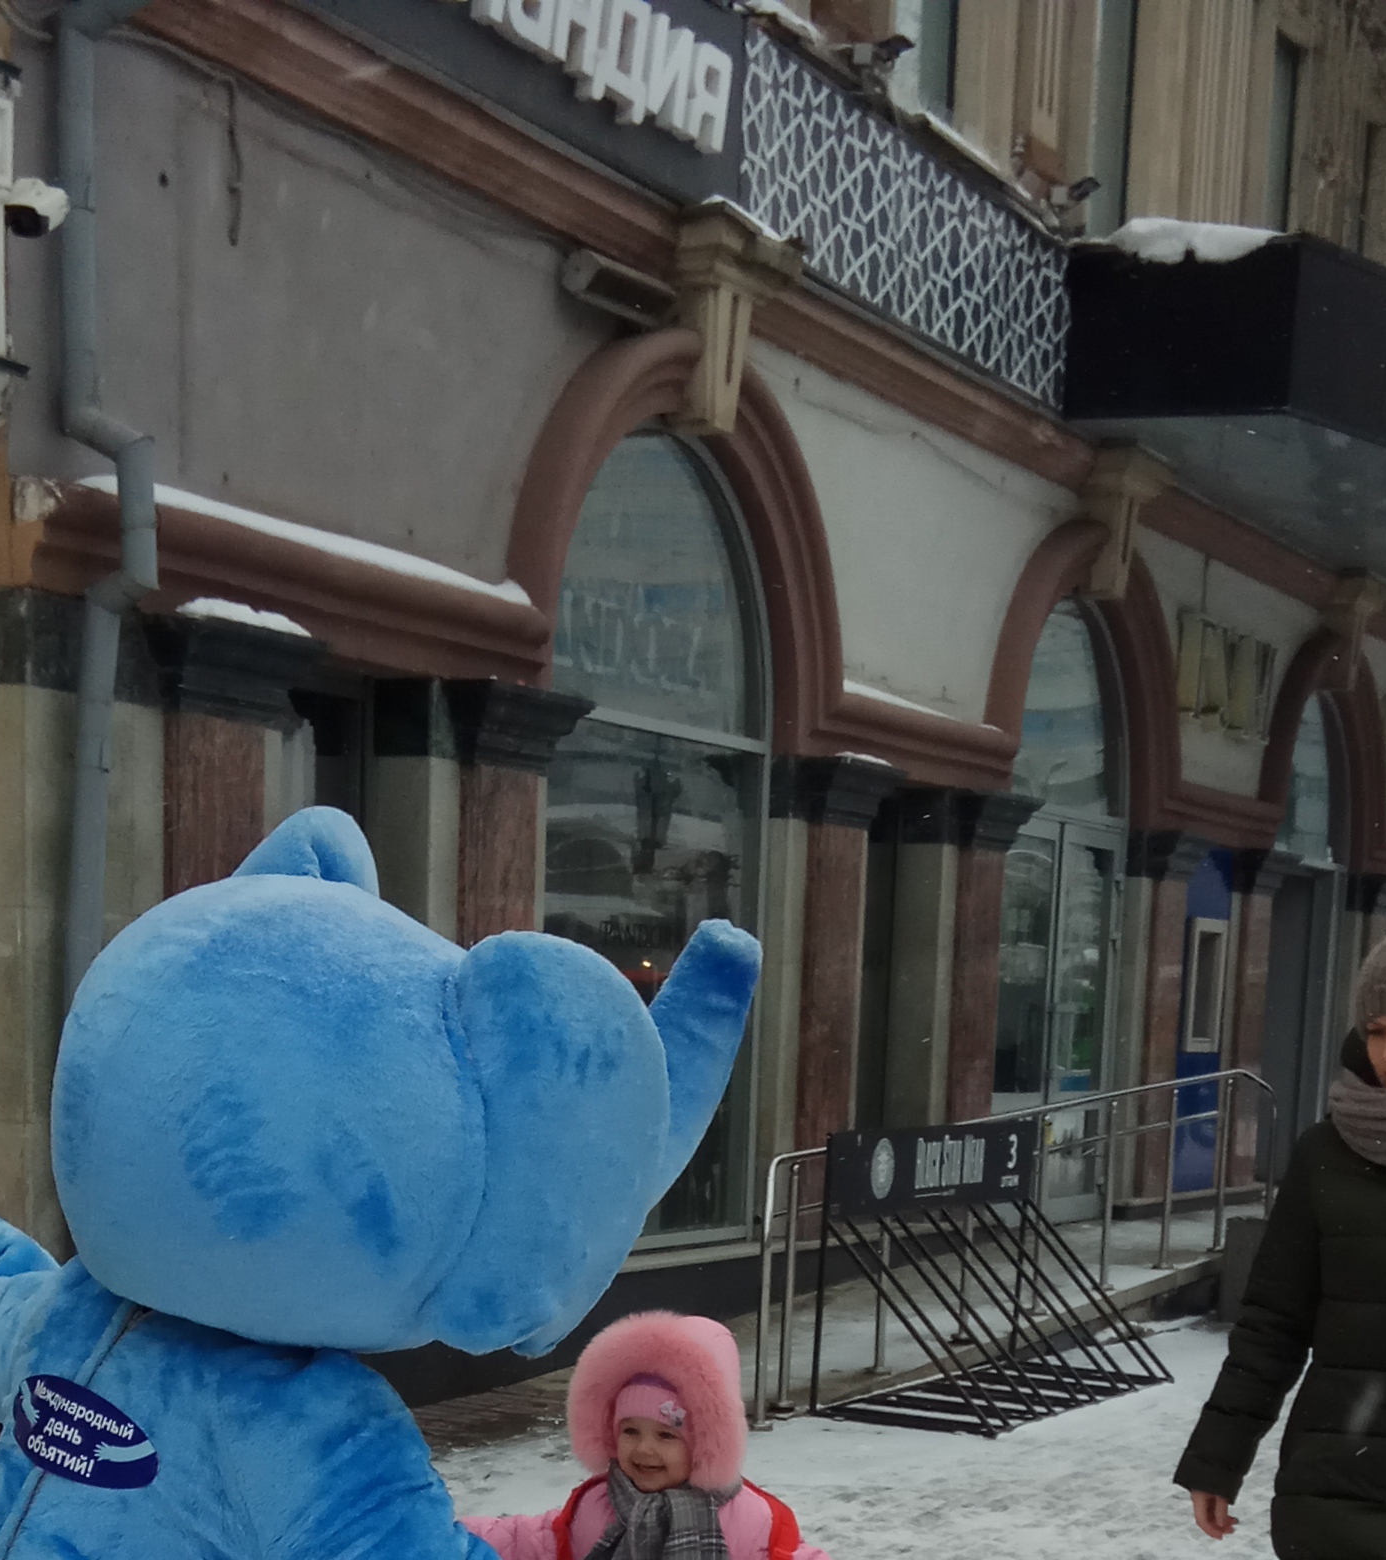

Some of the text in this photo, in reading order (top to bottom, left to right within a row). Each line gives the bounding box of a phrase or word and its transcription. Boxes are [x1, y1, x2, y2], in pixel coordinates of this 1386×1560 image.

[1006, 1133, 1018, 1169] 3
[34, 1379, 135, 1441] Международный
[43, 1417, 83, 1446] день
[27, 1435, 95, 1478] объятий!
